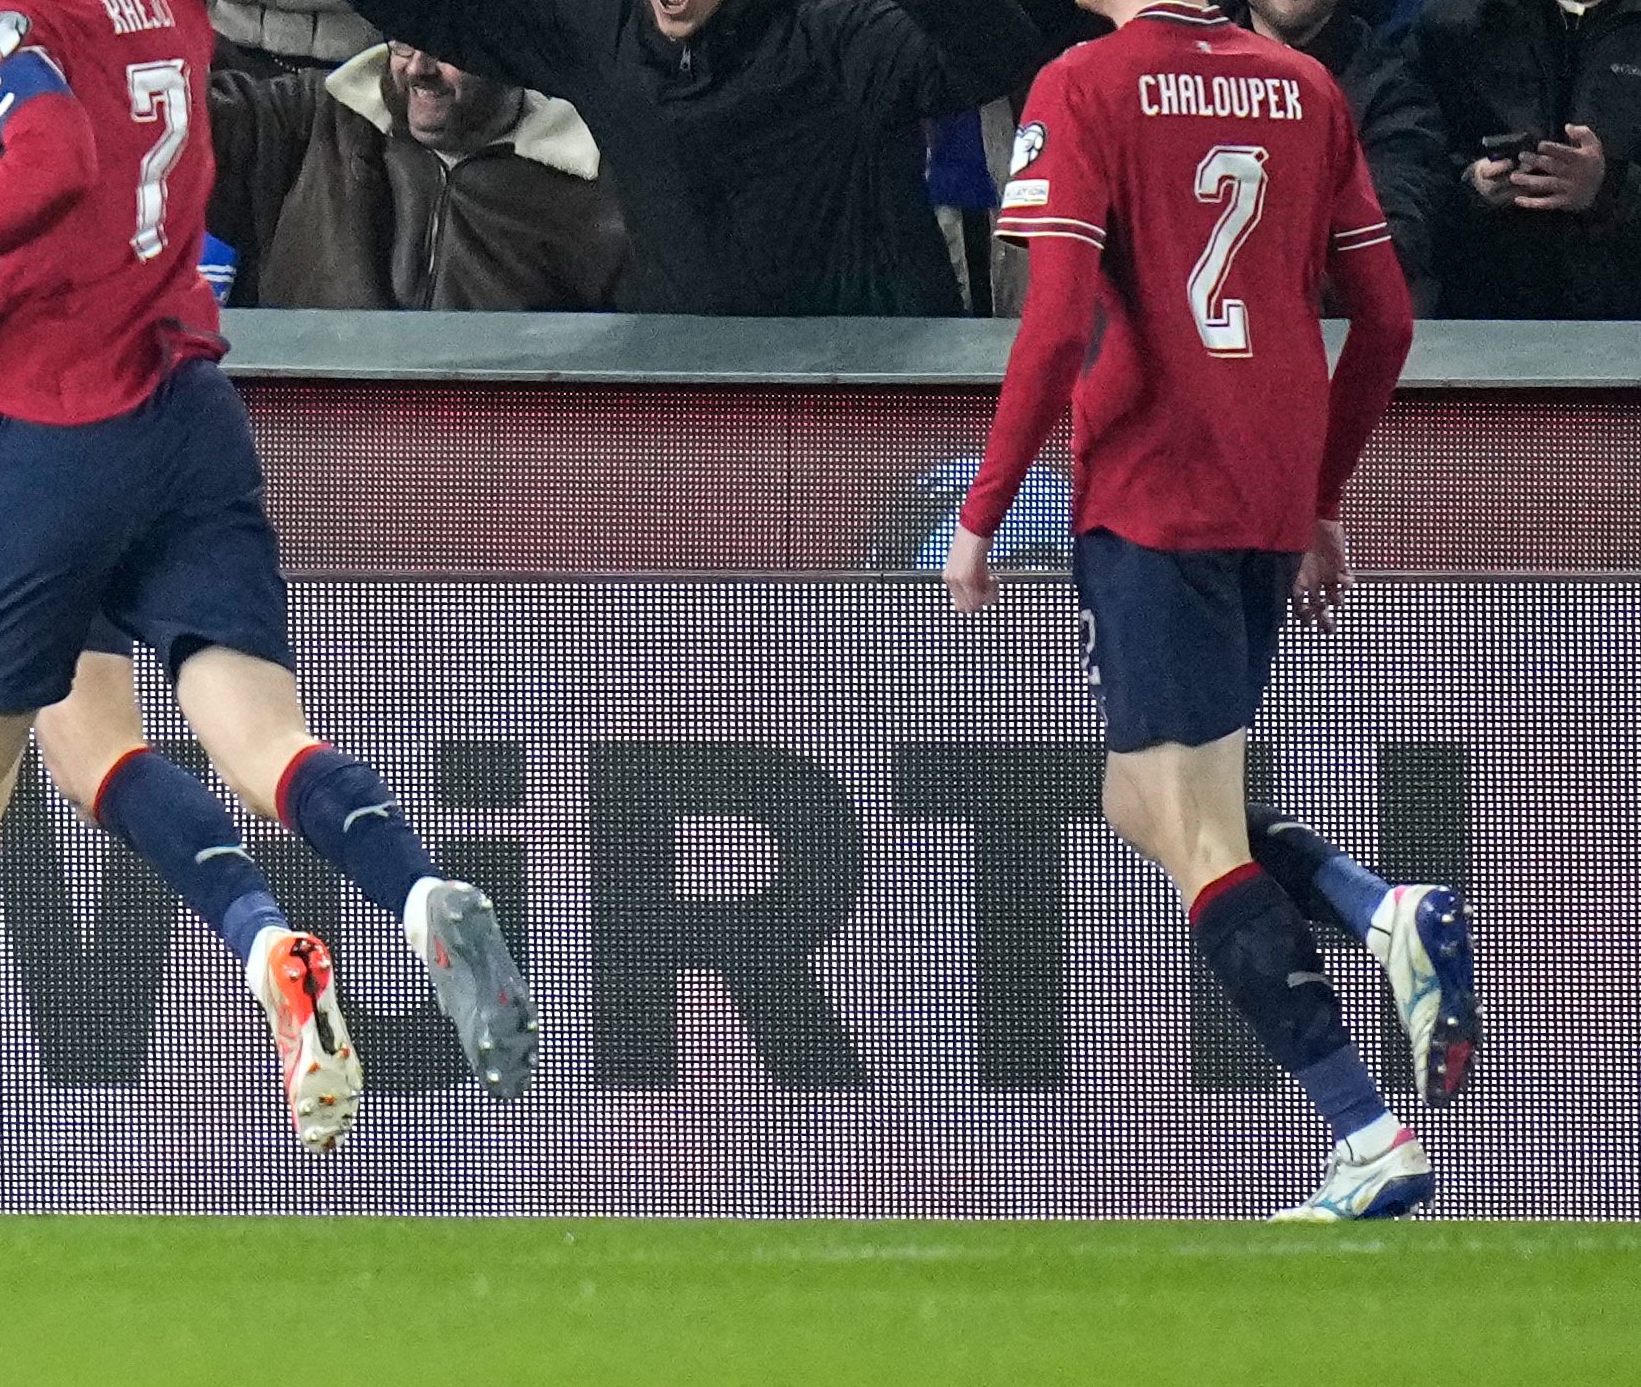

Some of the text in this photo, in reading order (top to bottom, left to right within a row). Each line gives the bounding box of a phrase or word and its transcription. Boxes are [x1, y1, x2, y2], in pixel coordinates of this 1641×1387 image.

[126, 58, 192, 264] 7
[1138, 73, 1303, 121] CHALOUPEK
[1186, 145, 1271, 360] 2
